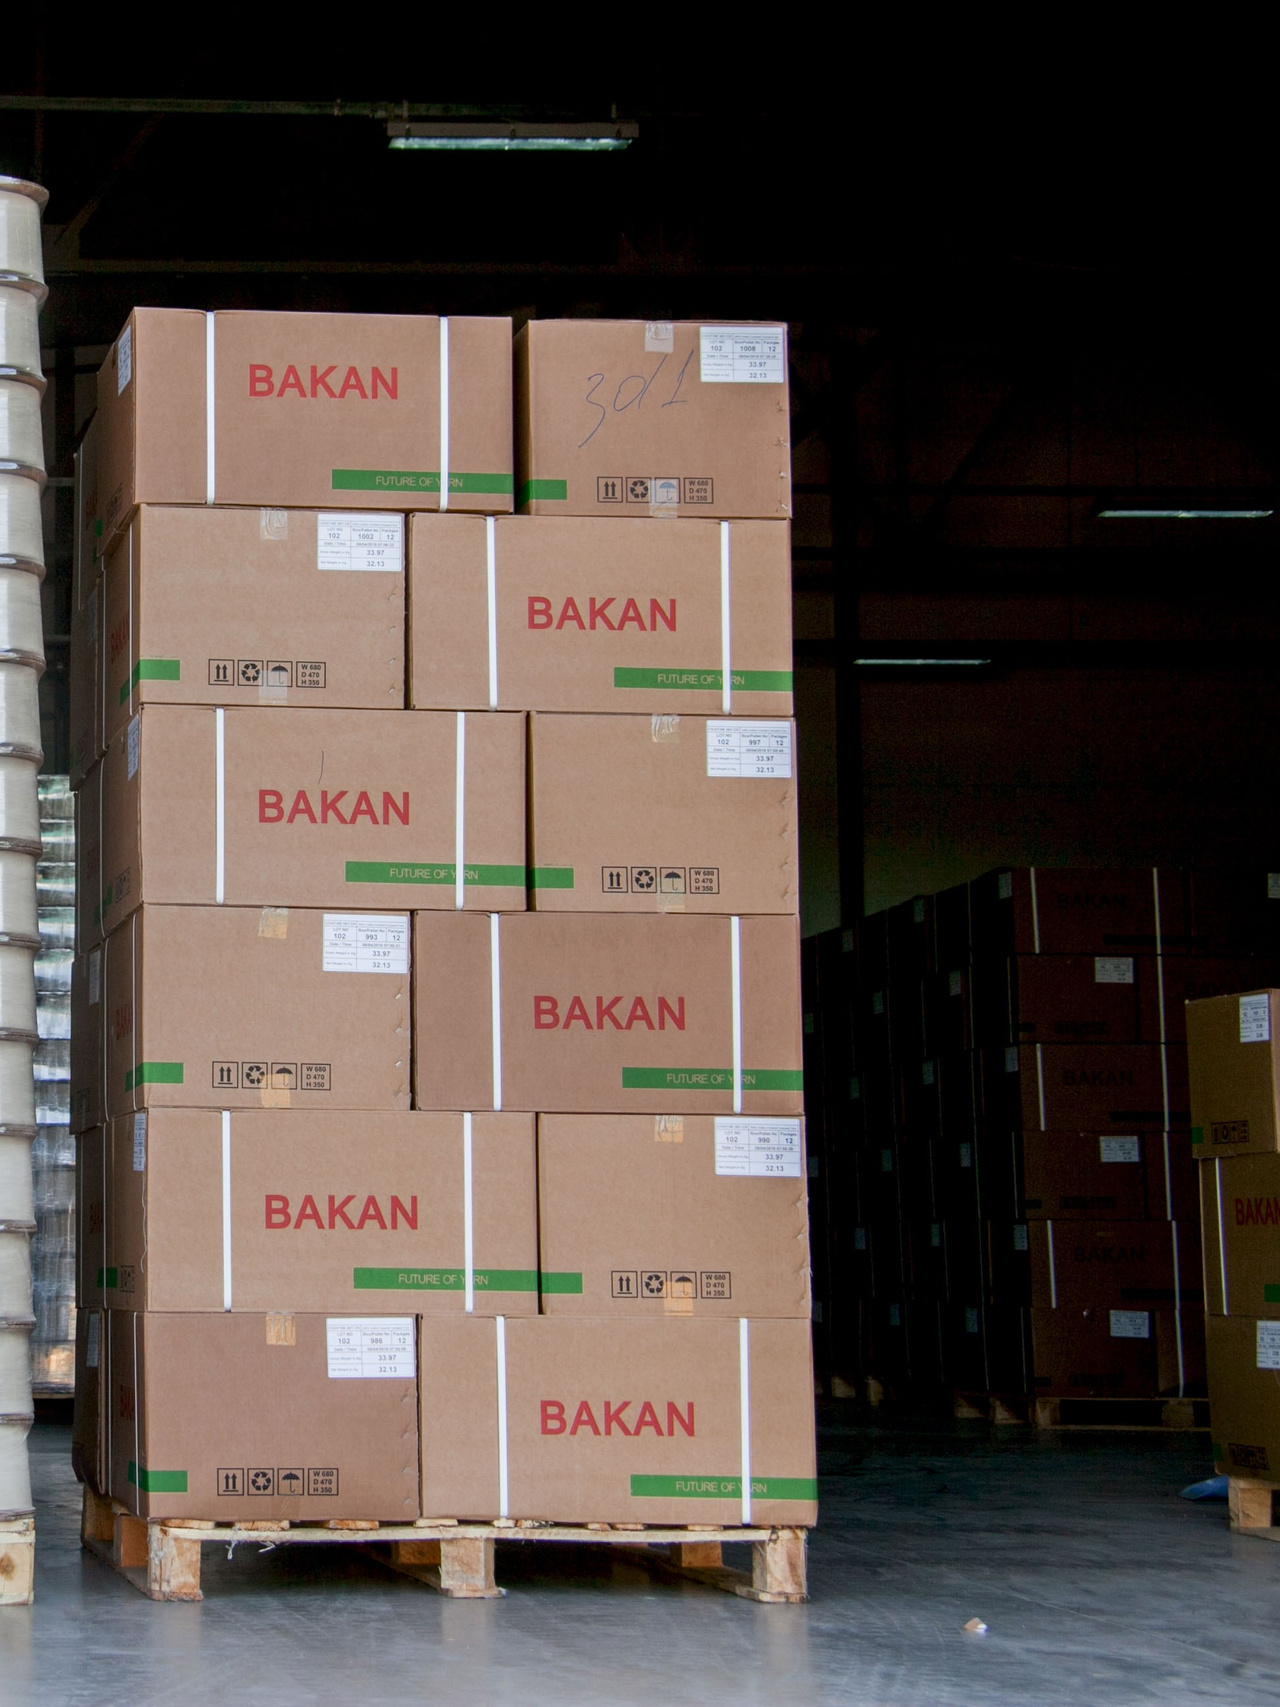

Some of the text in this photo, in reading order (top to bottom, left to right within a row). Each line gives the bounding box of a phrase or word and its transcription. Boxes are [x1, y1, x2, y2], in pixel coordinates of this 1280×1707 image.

[249, 364, 398, 400] BAKAN
[376, 476, 463, 488] FUTURE OF YRN
[528, 597, 676, 632] BAKAN
[657, 674, 745, 685] FUTURE OF YRN
[259, 790, 409, 825] BAKAN
[390, 868, 478, 880] FUTURE OF YRN
[534, 995, 685, 1031] BAKAN
[666, 1074, 756, 1085] FUTURE OF YRN
[265, 1195, 418, 1230] BAKAN
[398, 1274, 488, 1285] FUTURE OF YRN
[540, 1400, 694, 1437] BAKAN
[676, 1481, 718, 1492] FUTURE
[720, 1482, 736, 1492] OF
